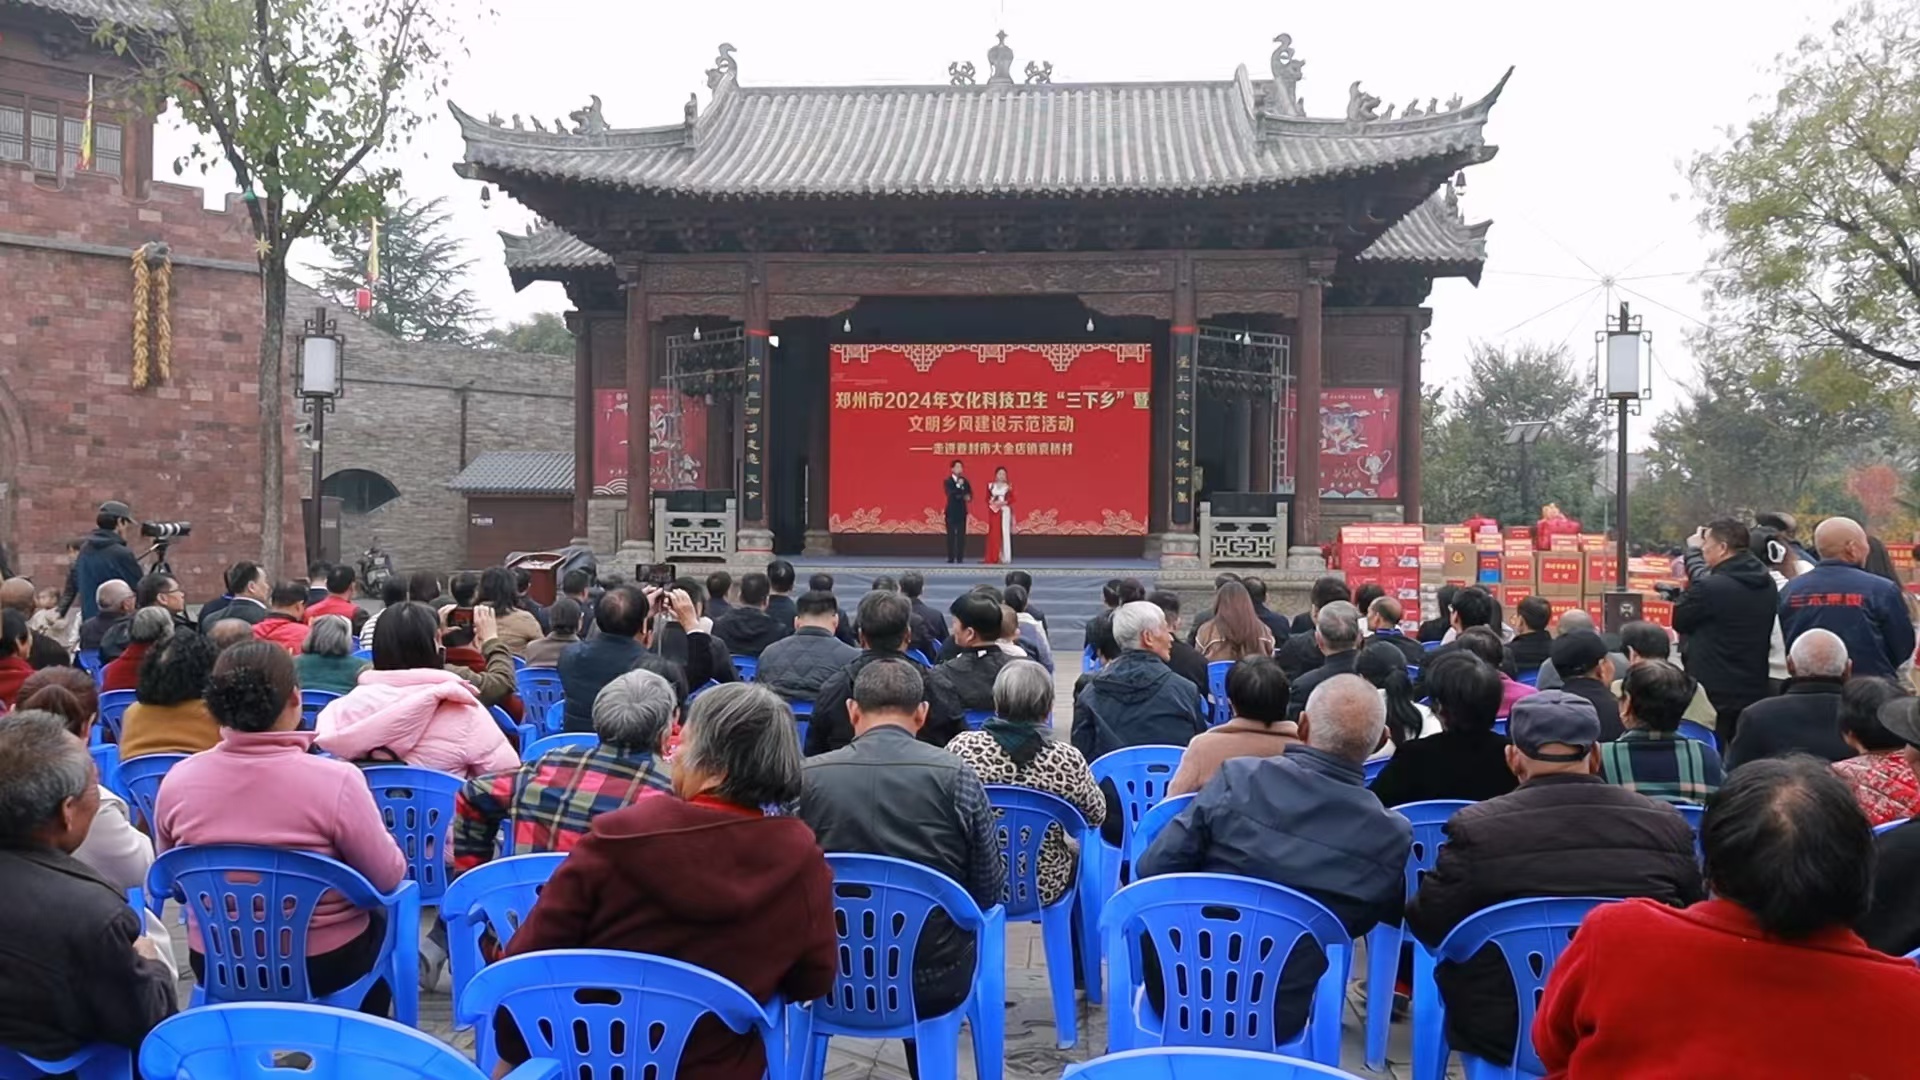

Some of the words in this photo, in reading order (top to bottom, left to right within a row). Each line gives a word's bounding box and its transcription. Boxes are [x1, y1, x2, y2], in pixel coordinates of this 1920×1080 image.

[835, 391, 1150, 409] 郑州市2024年文化科技卫生“三下乡”暨
[908, 415, 1075, 433] 文明乡风建设示范活动
